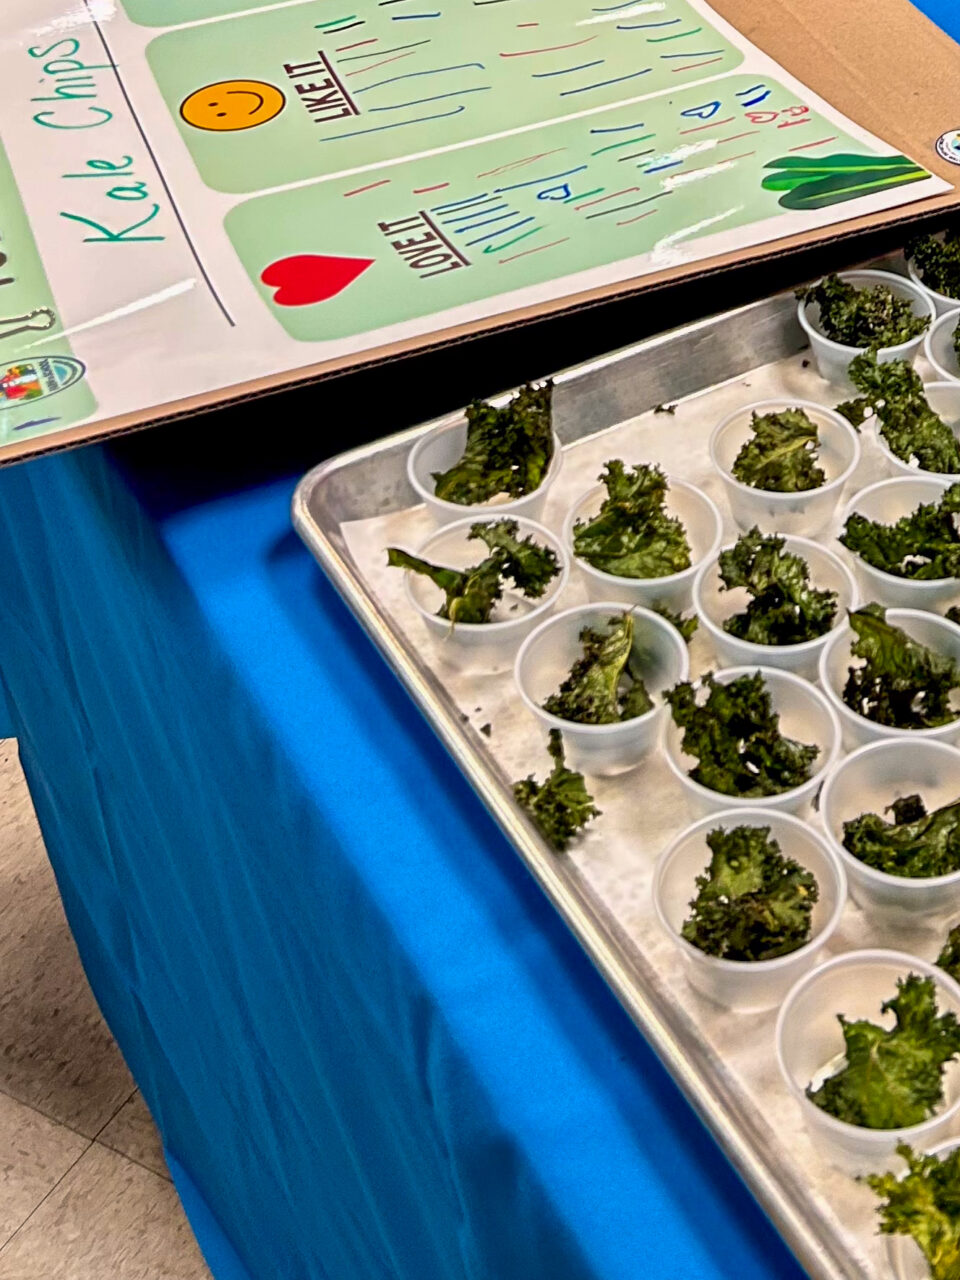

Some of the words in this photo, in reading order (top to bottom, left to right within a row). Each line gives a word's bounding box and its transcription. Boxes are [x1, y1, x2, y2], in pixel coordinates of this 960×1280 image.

[28, 38, 119, 130] Chips
[283, 60, 326, 79] IT
[294, 77, 353, 123] LIKE
[60, 154, 166, 243] Kale
[377, 216, 426, 236] IT
[391, 231, 462, 278] LOVE
